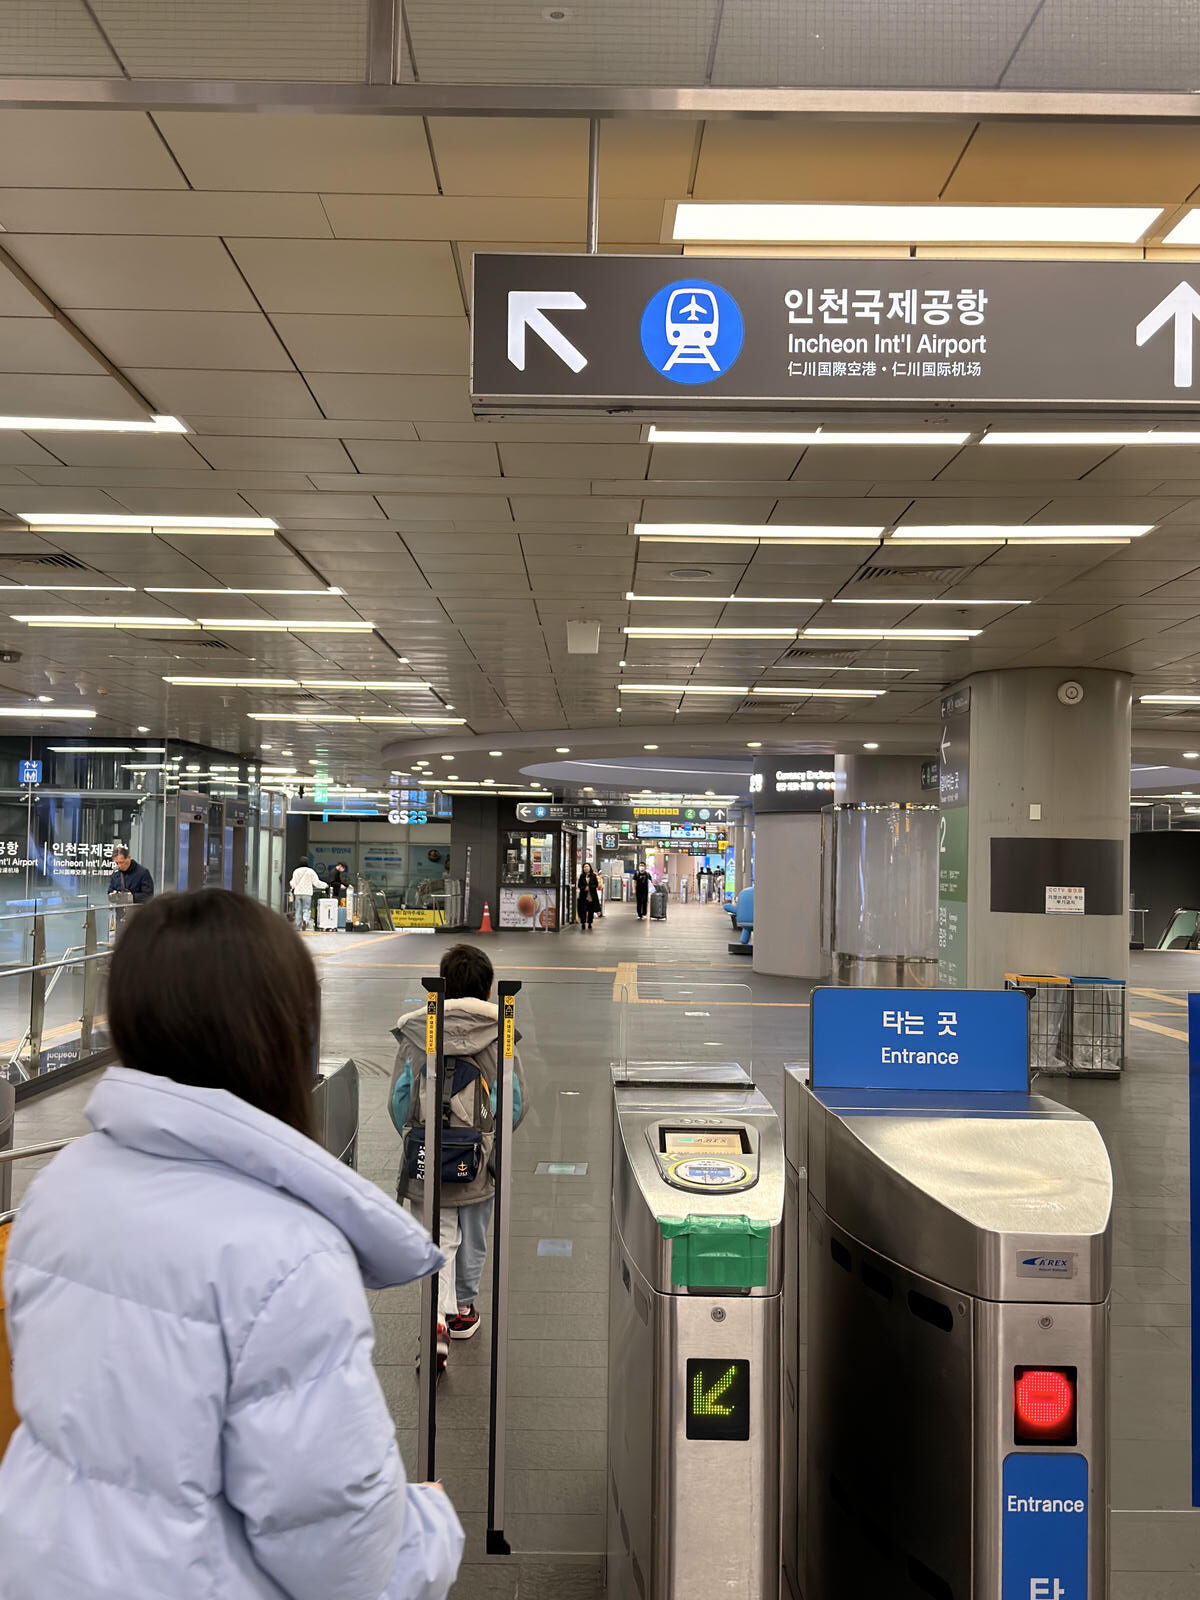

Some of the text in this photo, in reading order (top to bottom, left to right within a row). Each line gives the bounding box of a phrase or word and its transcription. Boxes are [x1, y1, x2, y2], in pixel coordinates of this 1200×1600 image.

[784, 288, 988, 326] 인천국제공항
[788, 333, 987, 358] Incheon Int'l Airport
[388, 810, 427, 824] GS25
[939, 816, 947, 853] 2
[12, 858, 39, 868] Airport
[53, 858, 84, 867] Incheon
[85, 858, 100, 867] Int'l
[883, 1010, 958, 1036] 타는 곳
[881, 1047, 959, 1065] Entrance
[1007, 1495, 1085, 1513] Entrance
